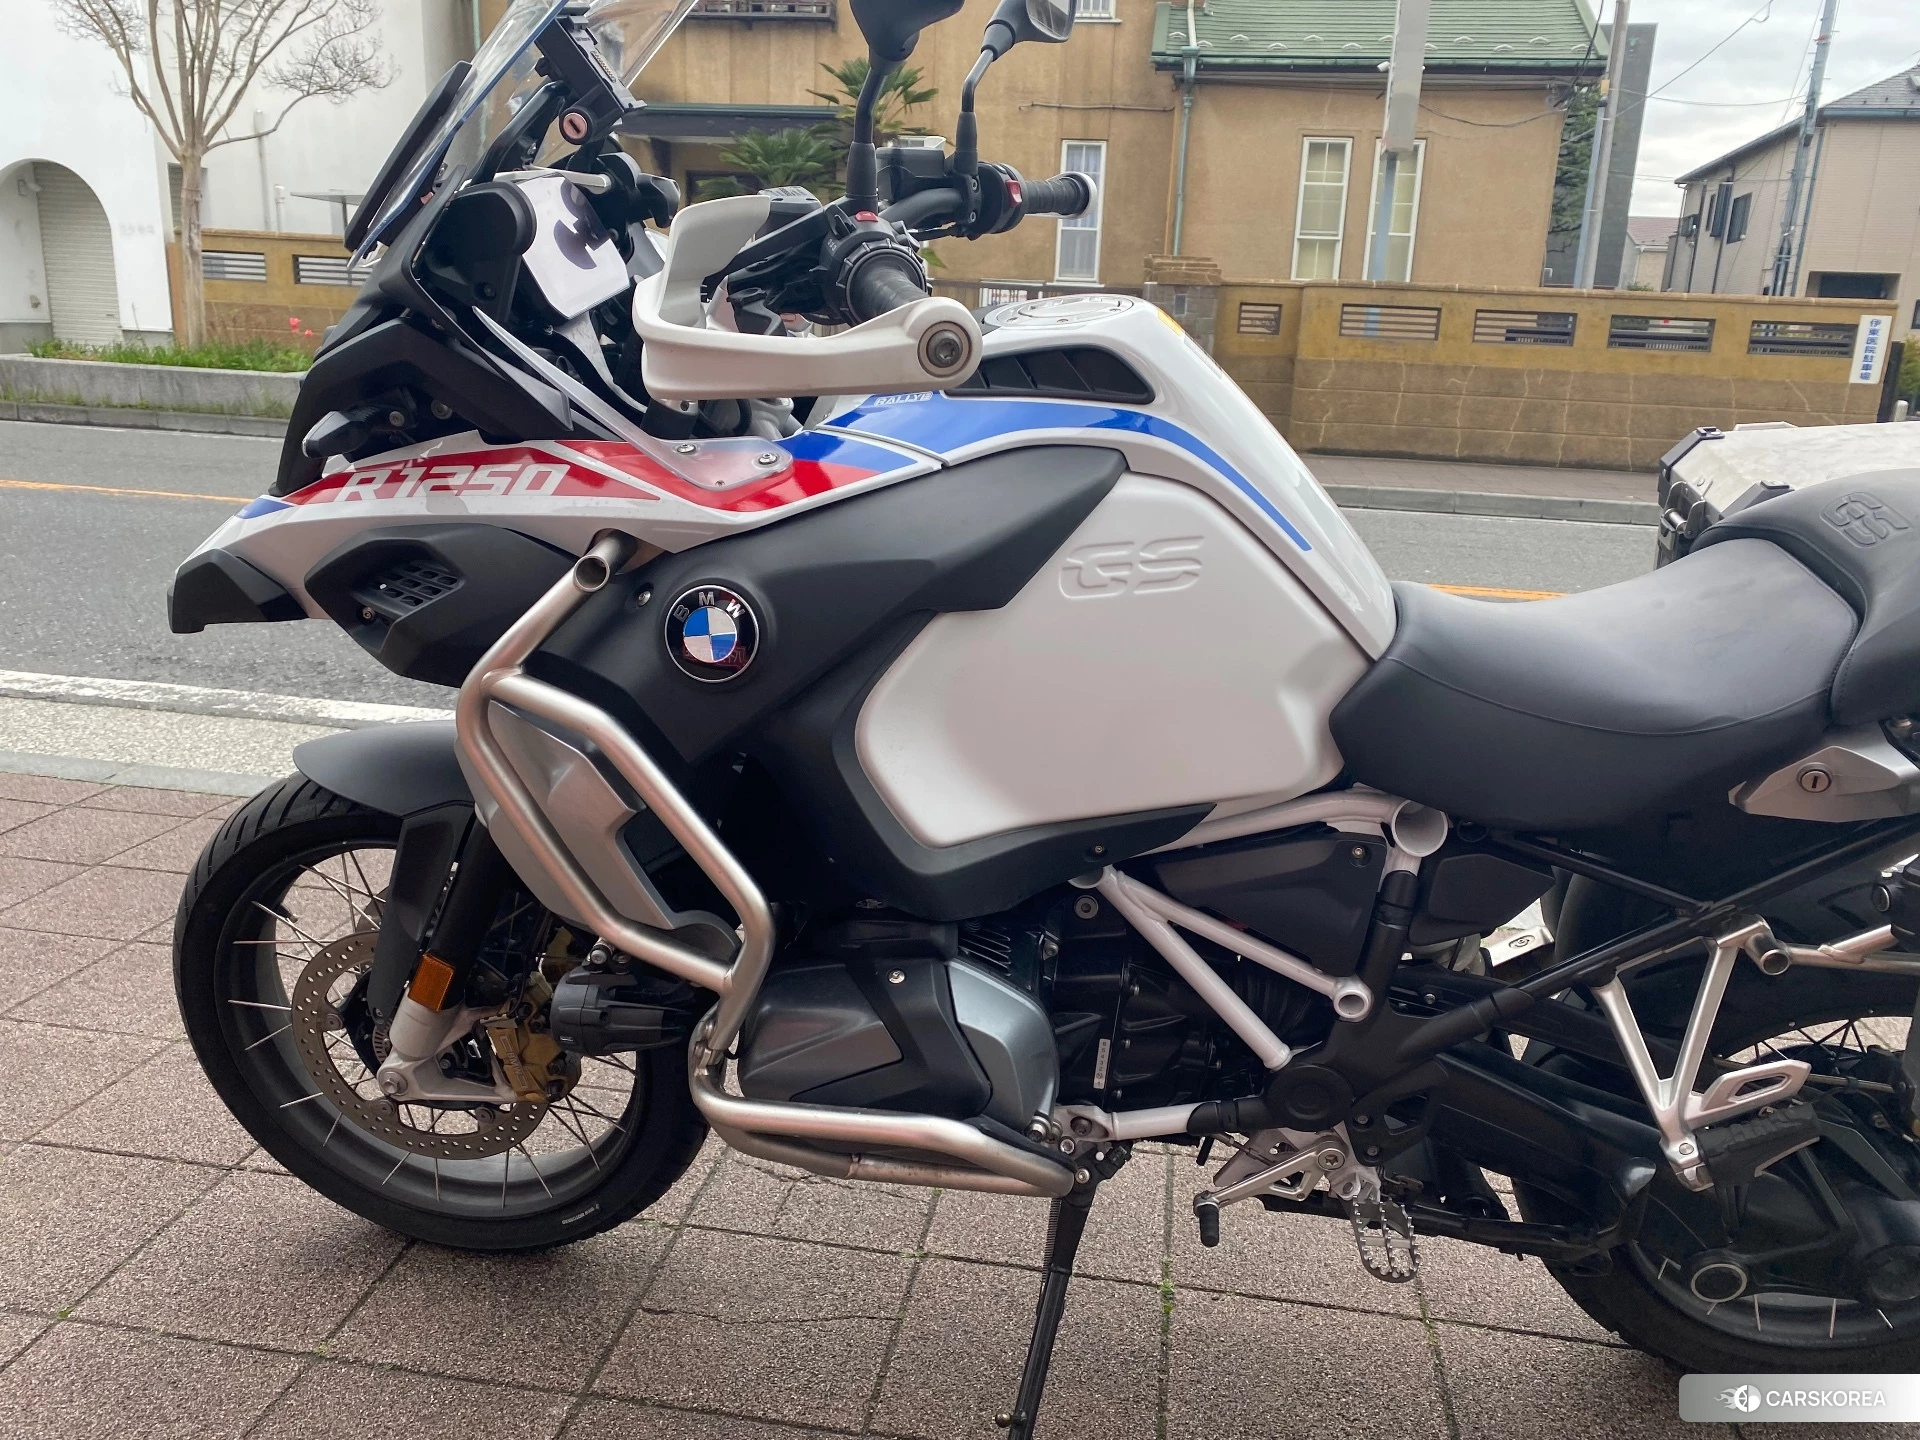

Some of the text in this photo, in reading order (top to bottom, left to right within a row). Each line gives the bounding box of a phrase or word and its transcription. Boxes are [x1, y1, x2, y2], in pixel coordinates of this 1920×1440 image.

[874, 391, 933, 406] RALLYE
[333, 464, 570, 502] R1250
[1058, 535, 1204, 600] GS
[673, 591, 746, 622] BMW
